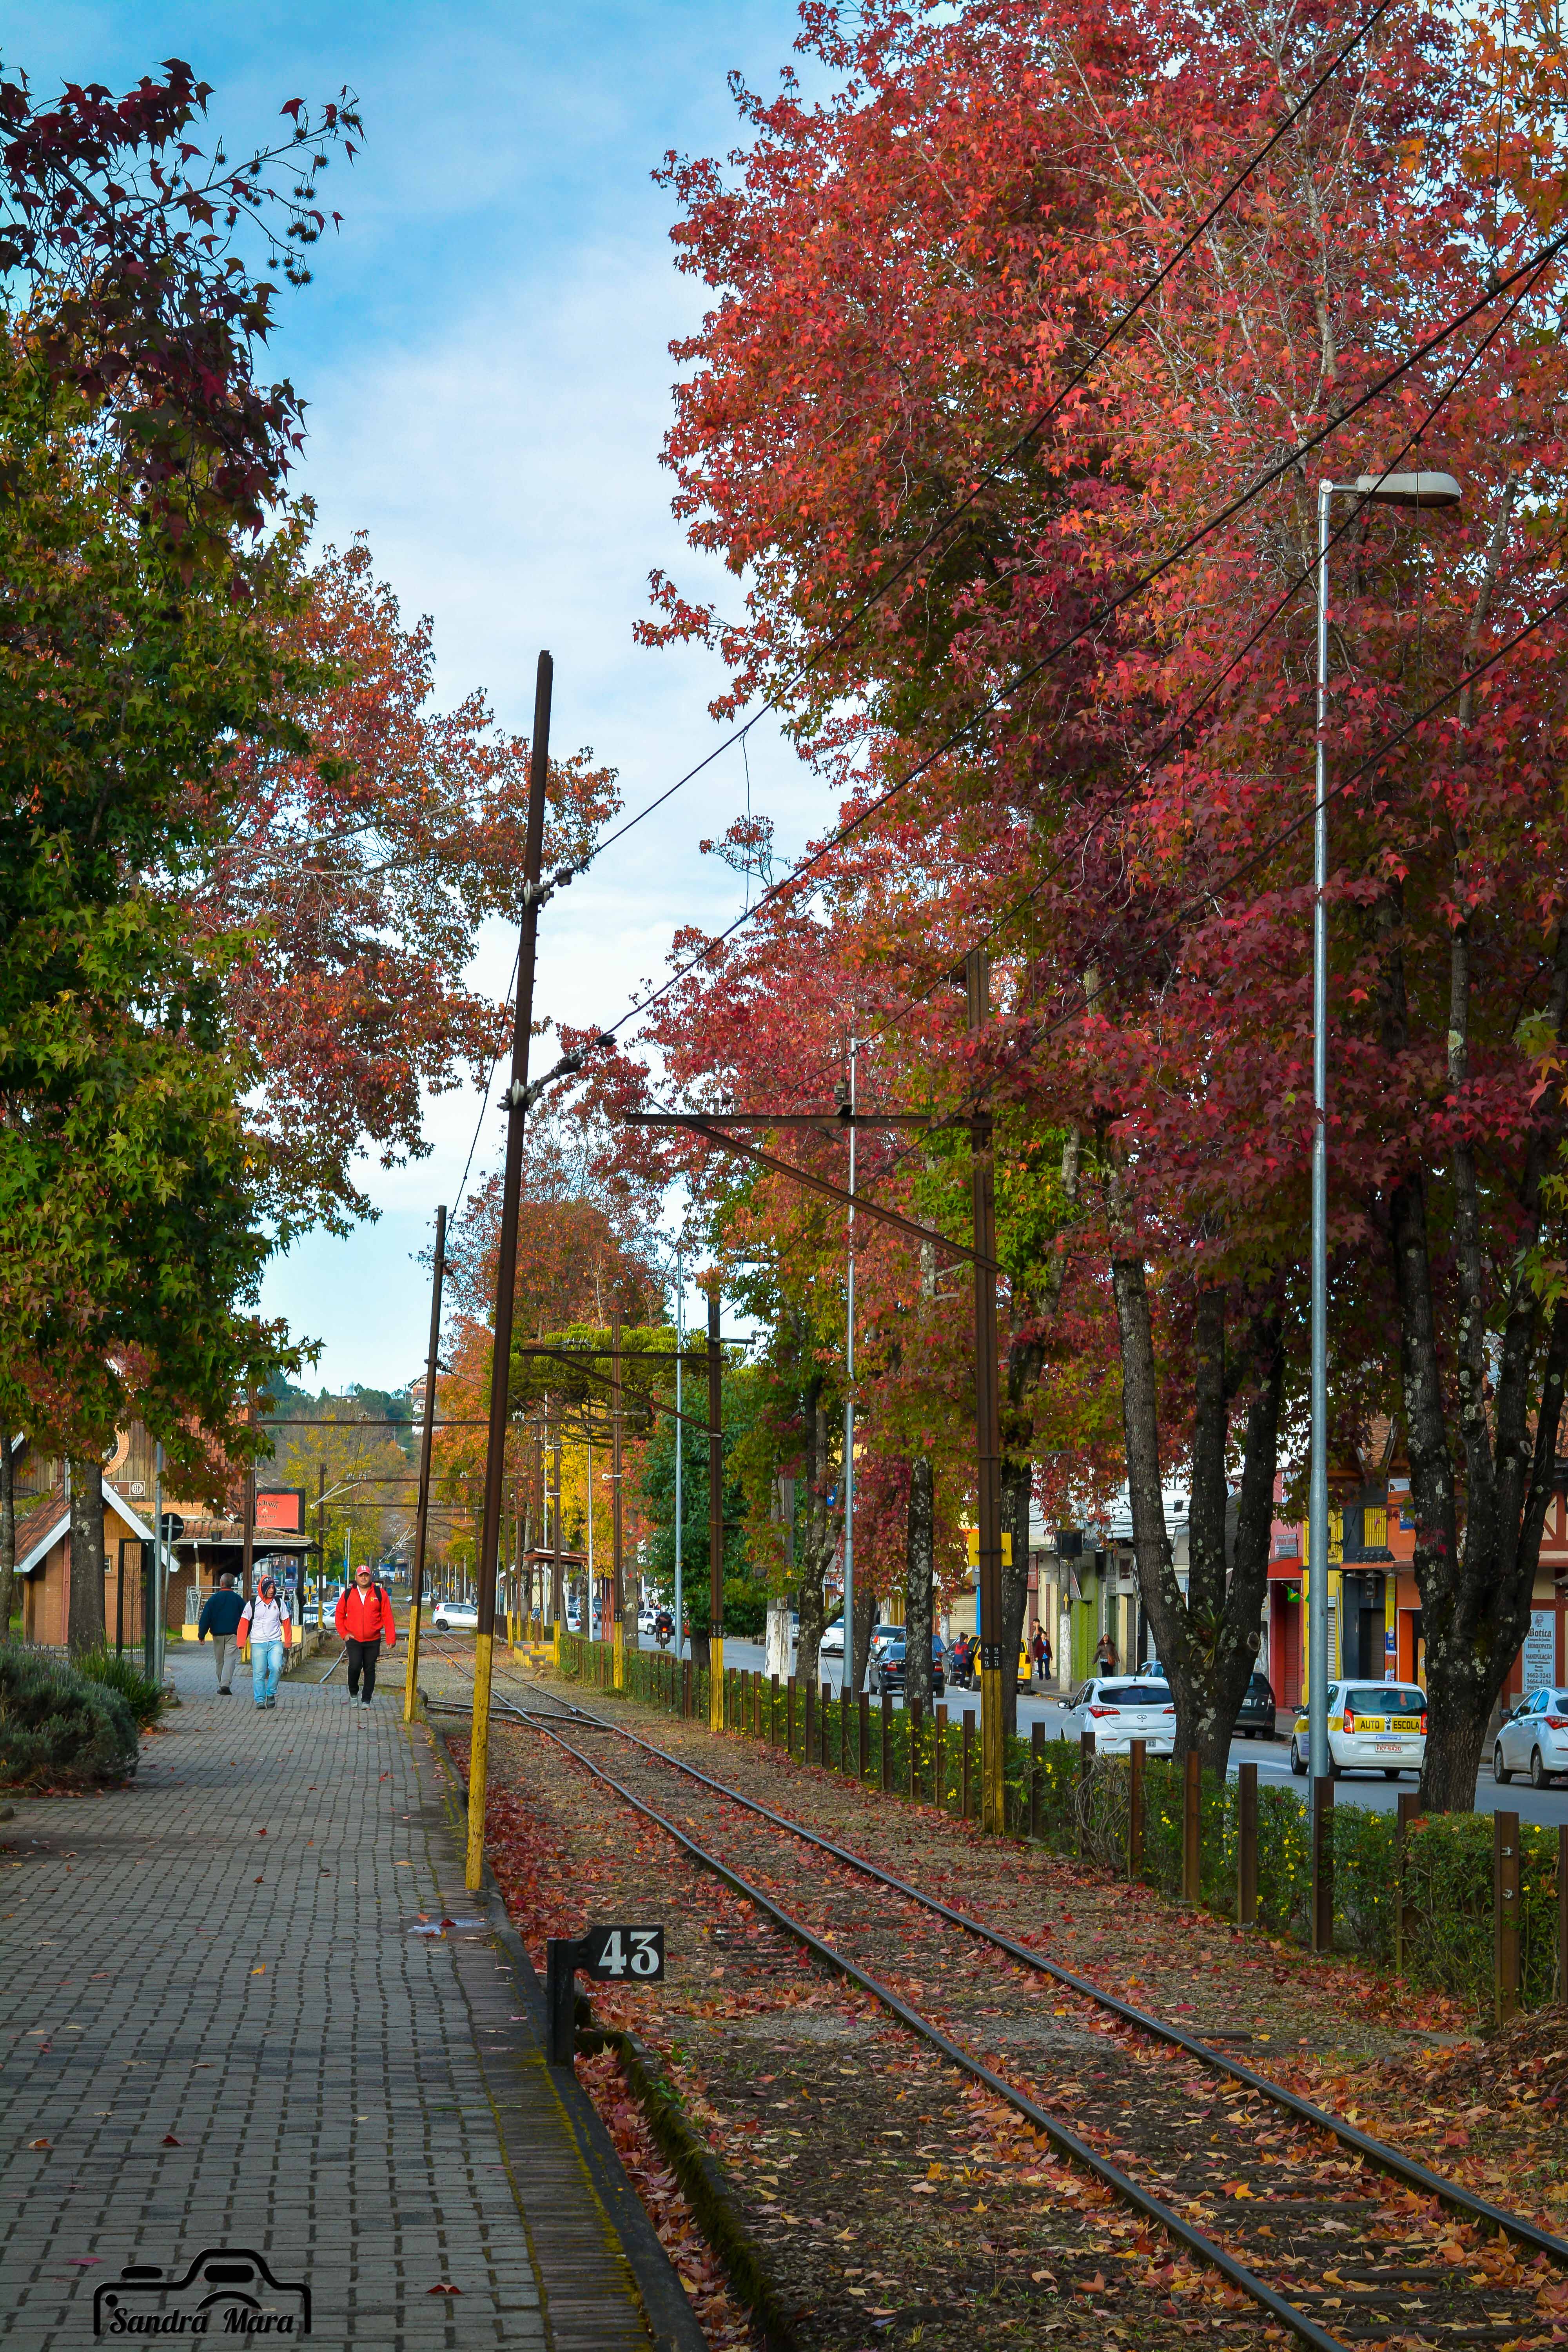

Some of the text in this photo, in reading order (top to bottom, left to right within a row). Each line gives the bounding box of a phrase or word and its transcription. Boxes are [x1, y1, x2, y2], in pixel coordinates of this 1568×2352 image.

[1528, 1628, 1552, 1637] Botica
[1361, 1720, 1420, 1730] AUTO ESCOLA
[598, 1931, 659, 1975] 43
